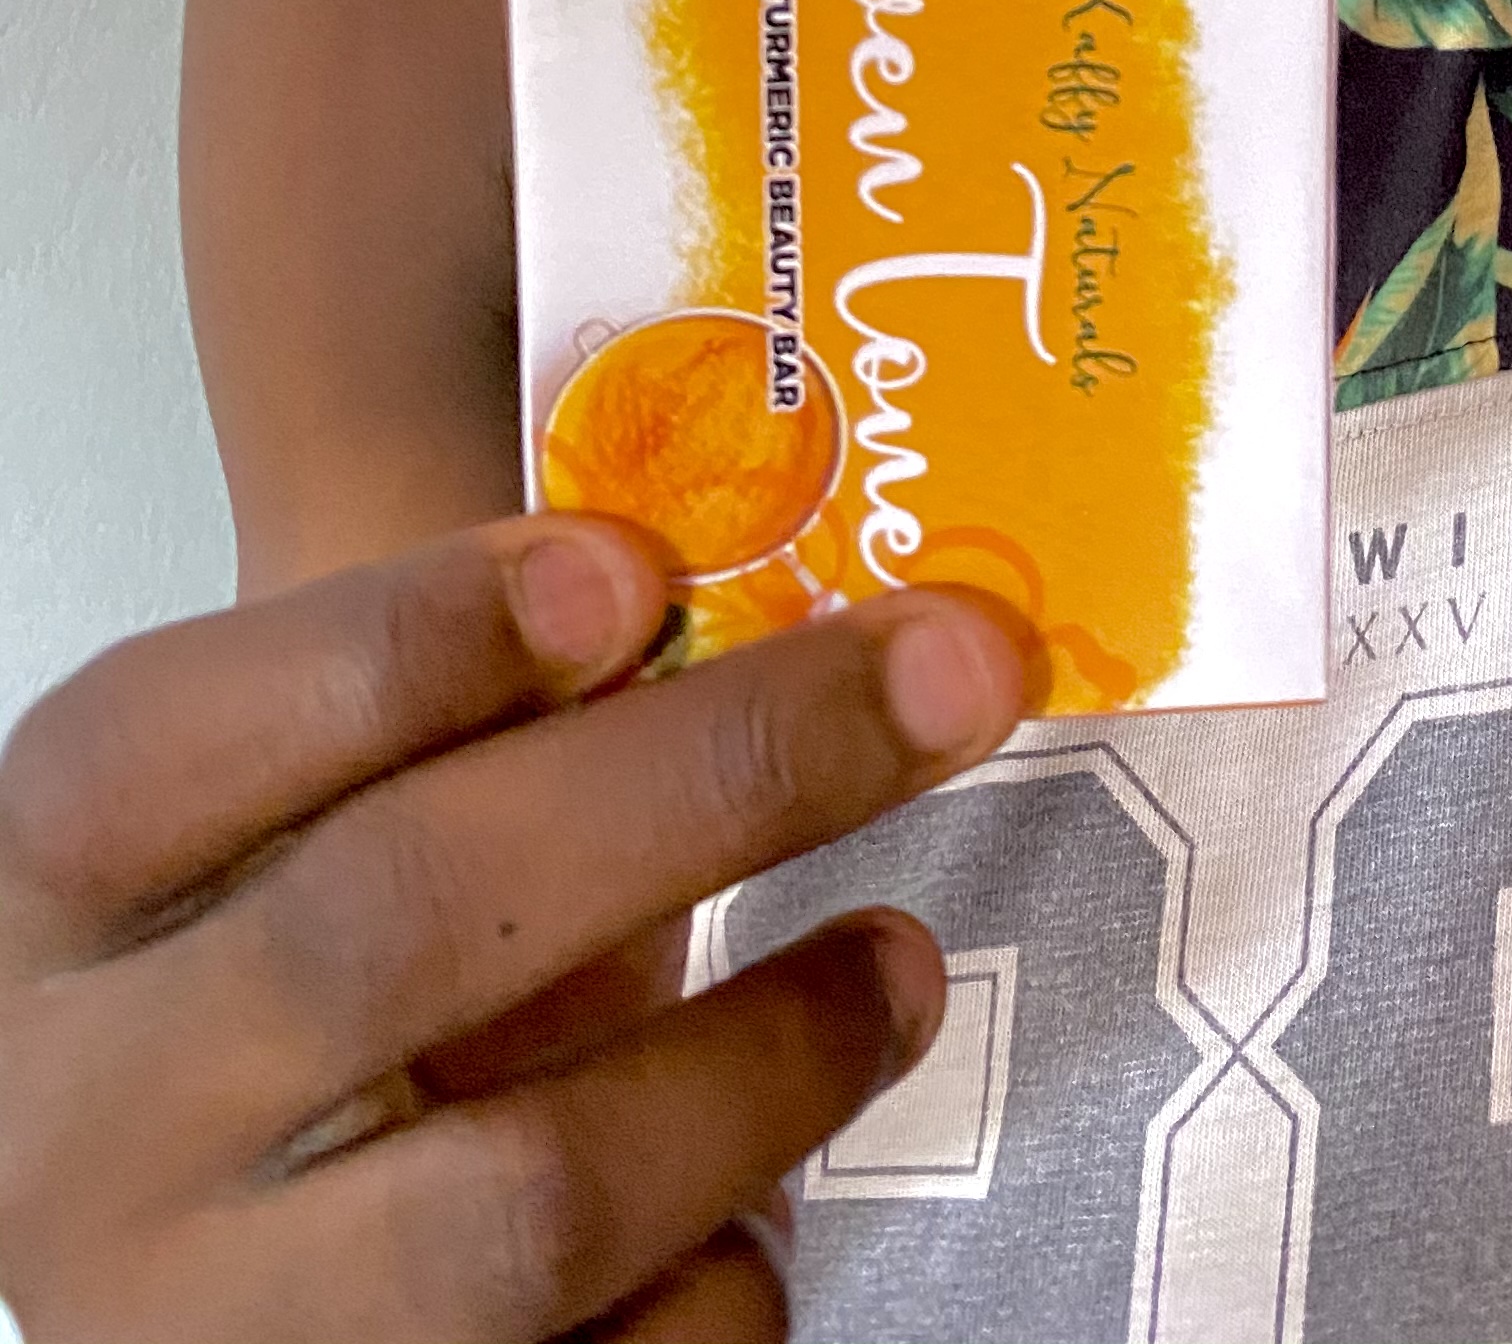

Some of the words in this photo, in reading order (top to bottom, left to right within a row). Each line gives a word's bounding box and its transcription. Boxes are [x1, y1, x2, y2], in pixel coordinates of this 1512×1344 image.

[766, 178, 799, 322] BEAUTY
[1063, 156, 1138, 397] Naturals
[770, 330, 801, 408] BAR
[833, 161, 1057, 588] Tone
